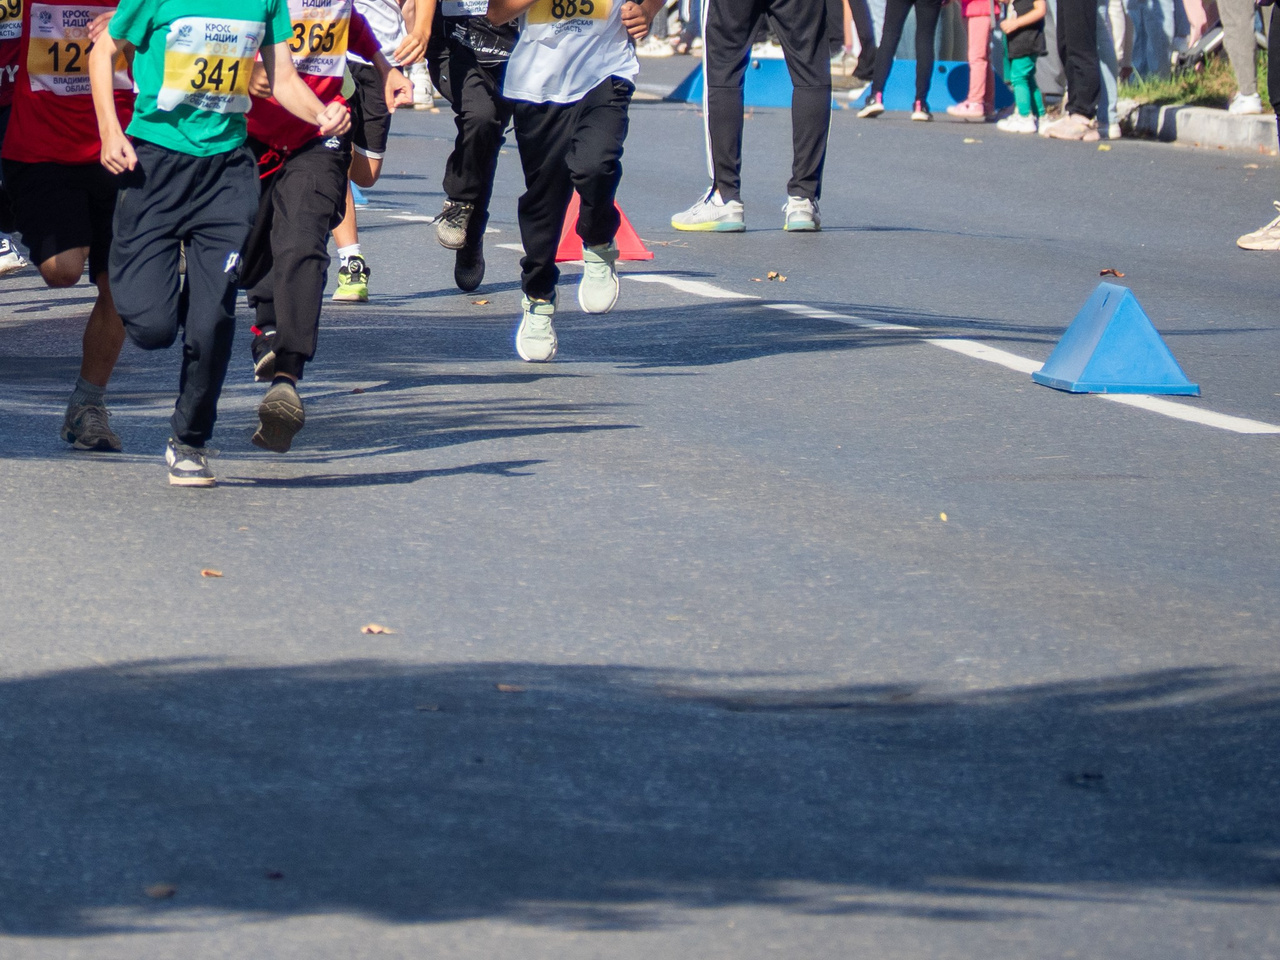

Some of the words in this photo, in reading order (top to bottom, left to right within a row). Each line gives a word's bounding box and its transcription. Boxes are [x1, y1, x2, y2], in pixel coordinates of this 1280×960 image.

[62, 9, 89, 19] КРОСС
[205, 23, 231, 33] КРОСС
[204, 33, 238, 43] НАЦИИ
[289, 22, 337, 53] 365
[190, 57, 240, 92] 341
[65, 84, 90, 93] ОБЛАС
